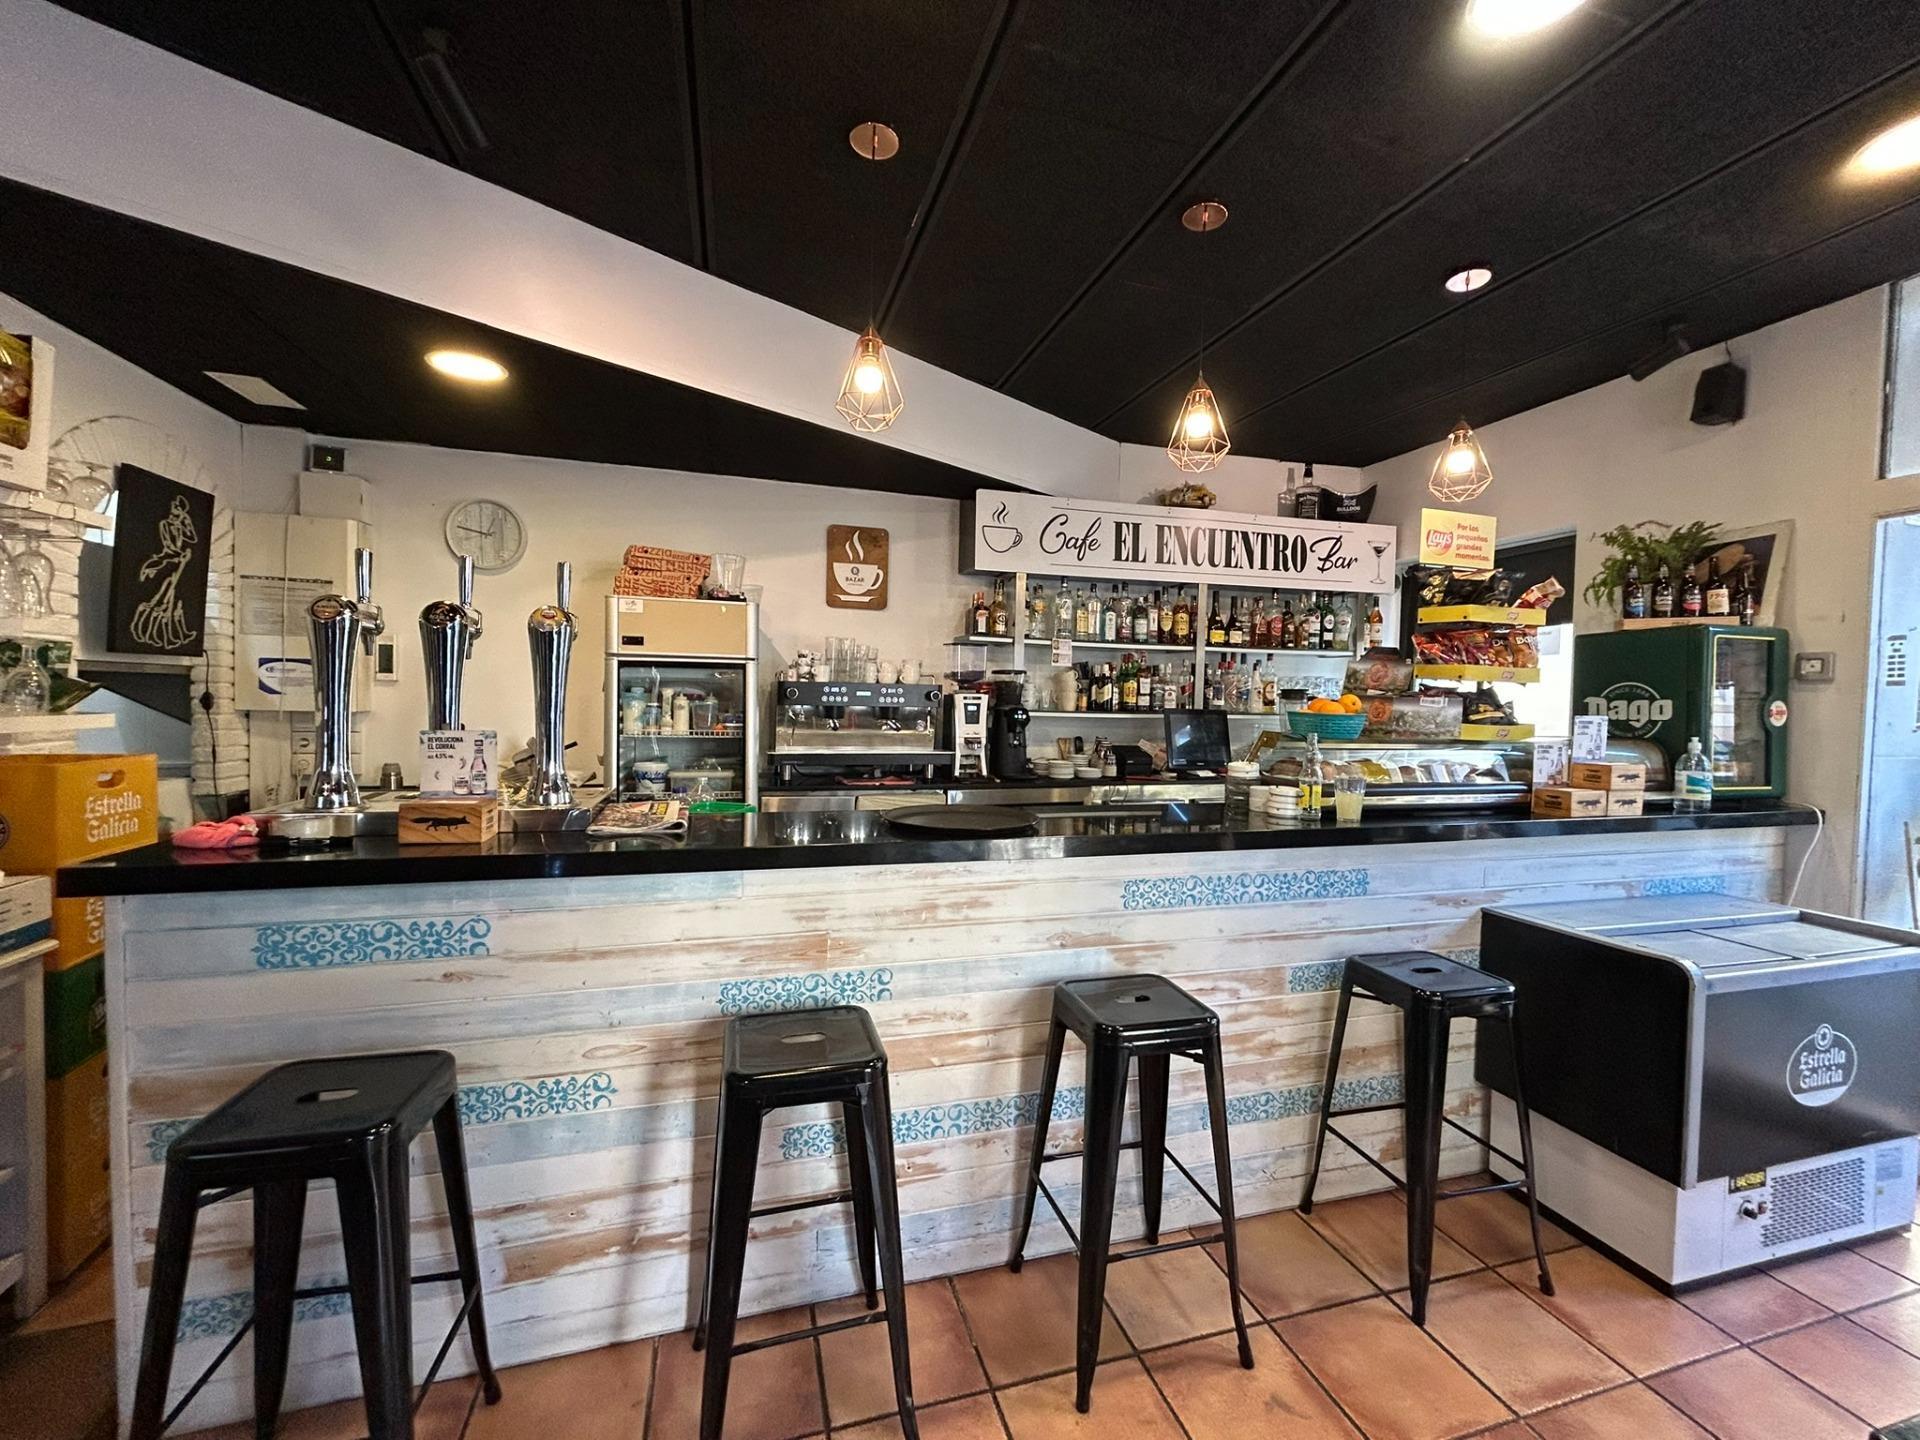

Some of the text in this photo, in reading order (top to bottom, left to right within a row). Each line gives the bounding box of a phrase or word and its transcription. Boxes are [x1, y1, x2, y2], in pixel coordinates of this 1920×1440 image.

[1457, 523, 1480, 532] Por los
[1039, 513, 1358, 574] Cafe EL ENCUENTRO Bar
[1455, 544, 1482, 552] grandes
[85, 791, 142, 819] Estrella
[87, 814, 139, 843] Galicia
[1799, 1047, 1847, 1070] Estrella
[1799, 1065, 1844, 1089] Galicia
